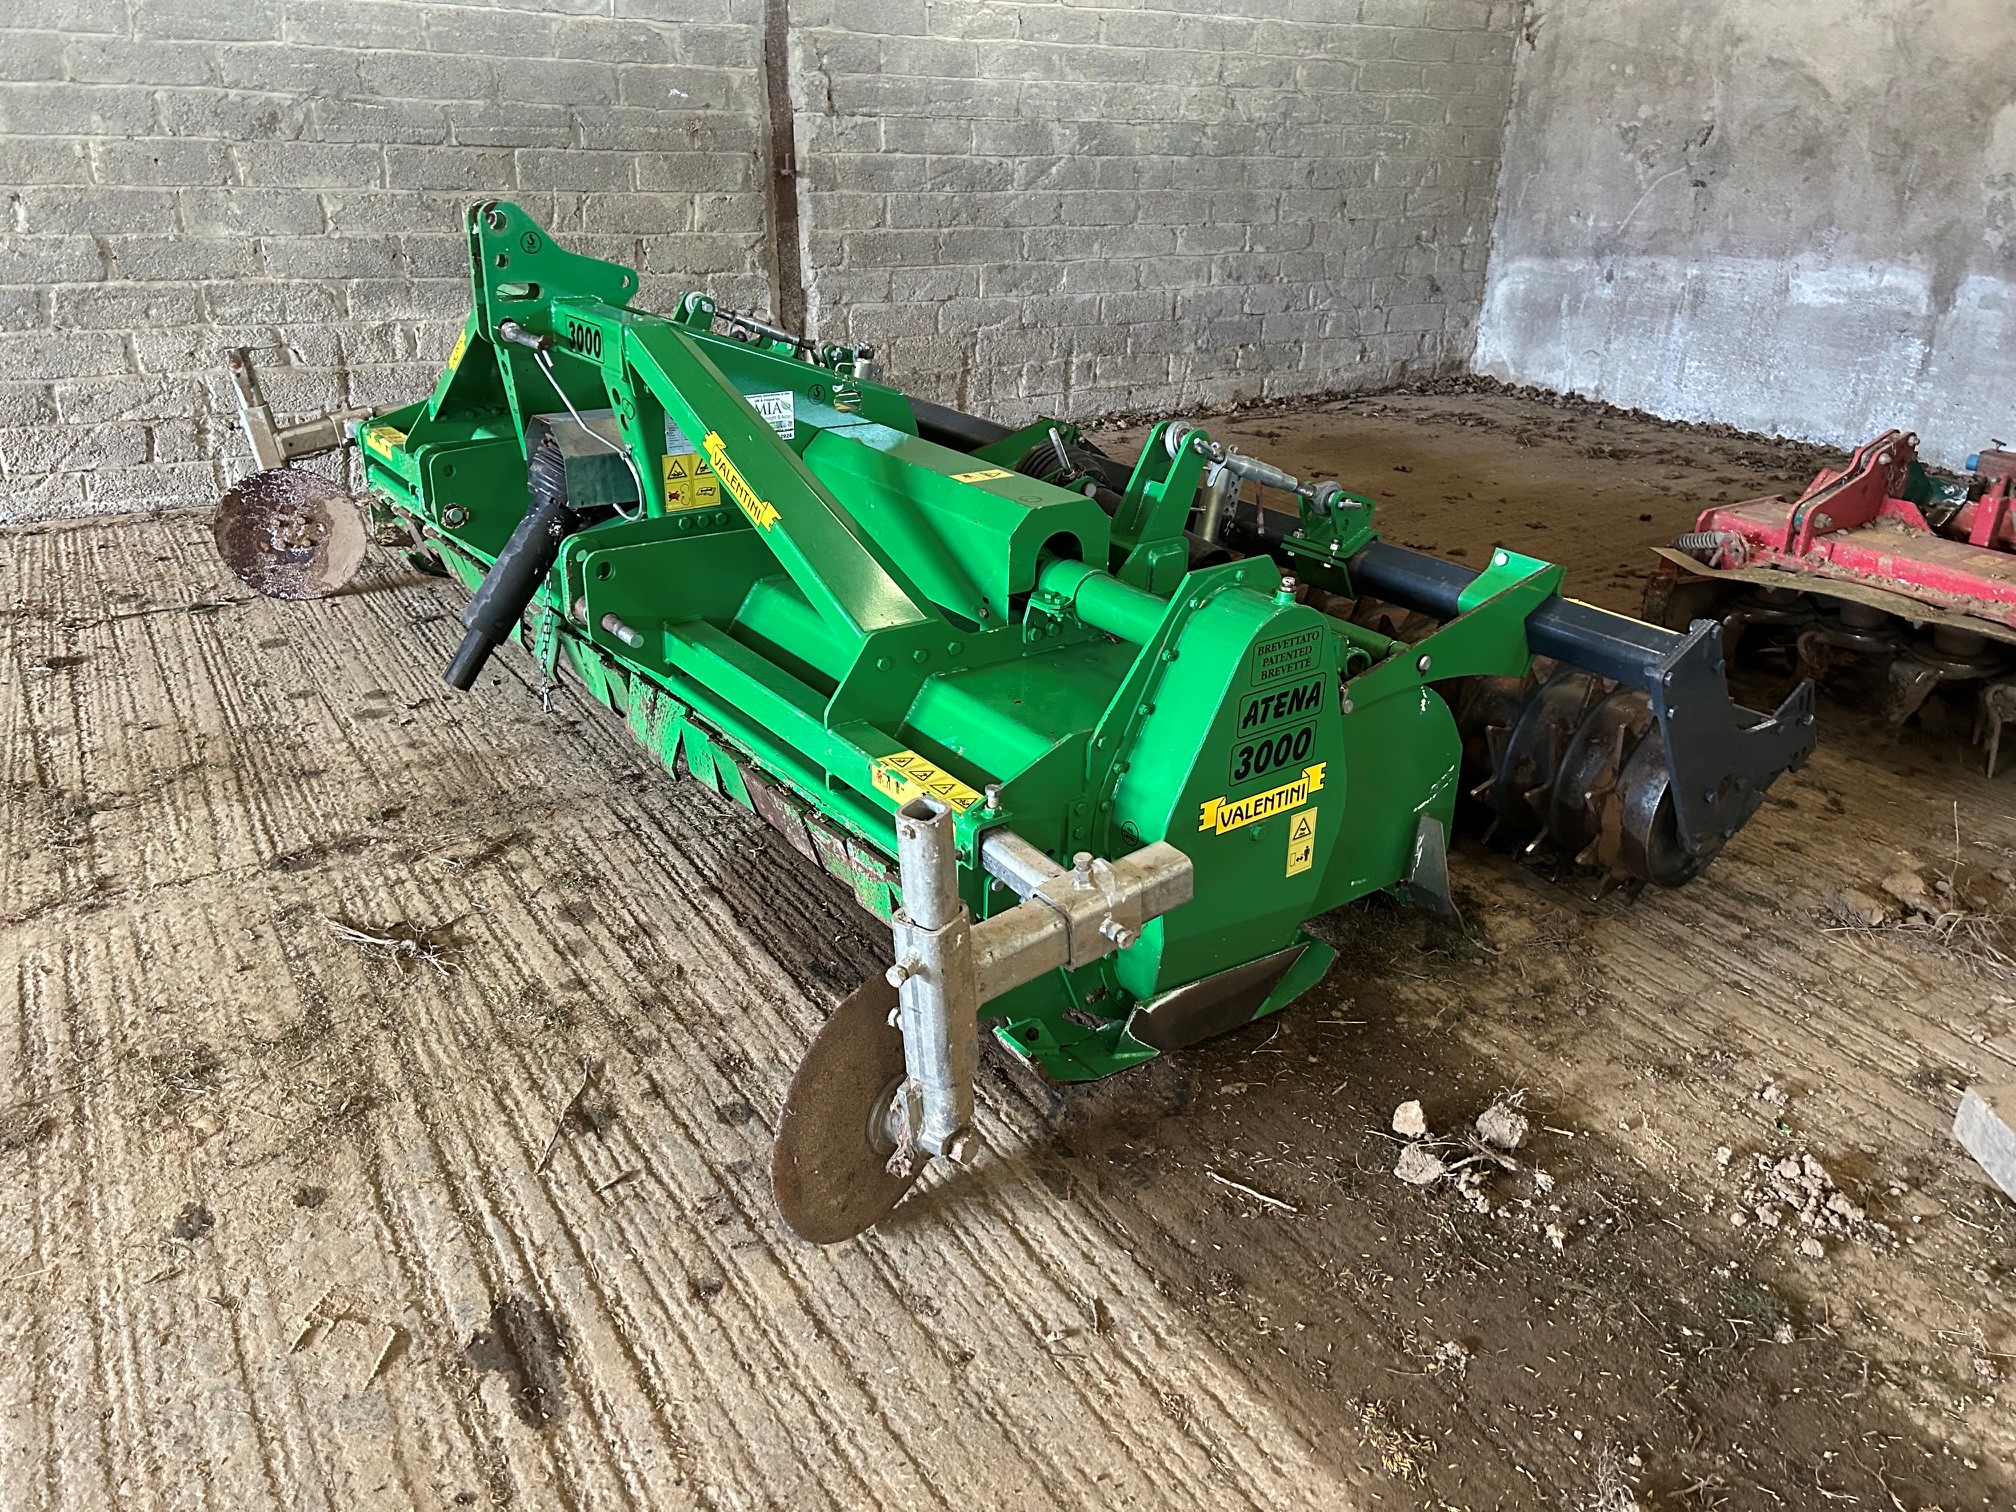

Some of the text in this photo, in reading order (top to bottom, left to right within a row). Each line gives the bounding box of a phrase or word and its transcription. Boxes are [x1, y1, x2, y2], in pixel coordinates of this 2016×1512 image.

[568, 320, 602, 359] 3000
[713, 451, 761, 520] VALENTINI
[1258, 631, 1320, 656] BREVETTATO
[1262, 645, 1312, 667] PATENTED
[1242, 681, 1321, 729] ATENA
[1234, 727, 1312, 780] 3000
[1220, 783, 1306, 827] VALENTINI
